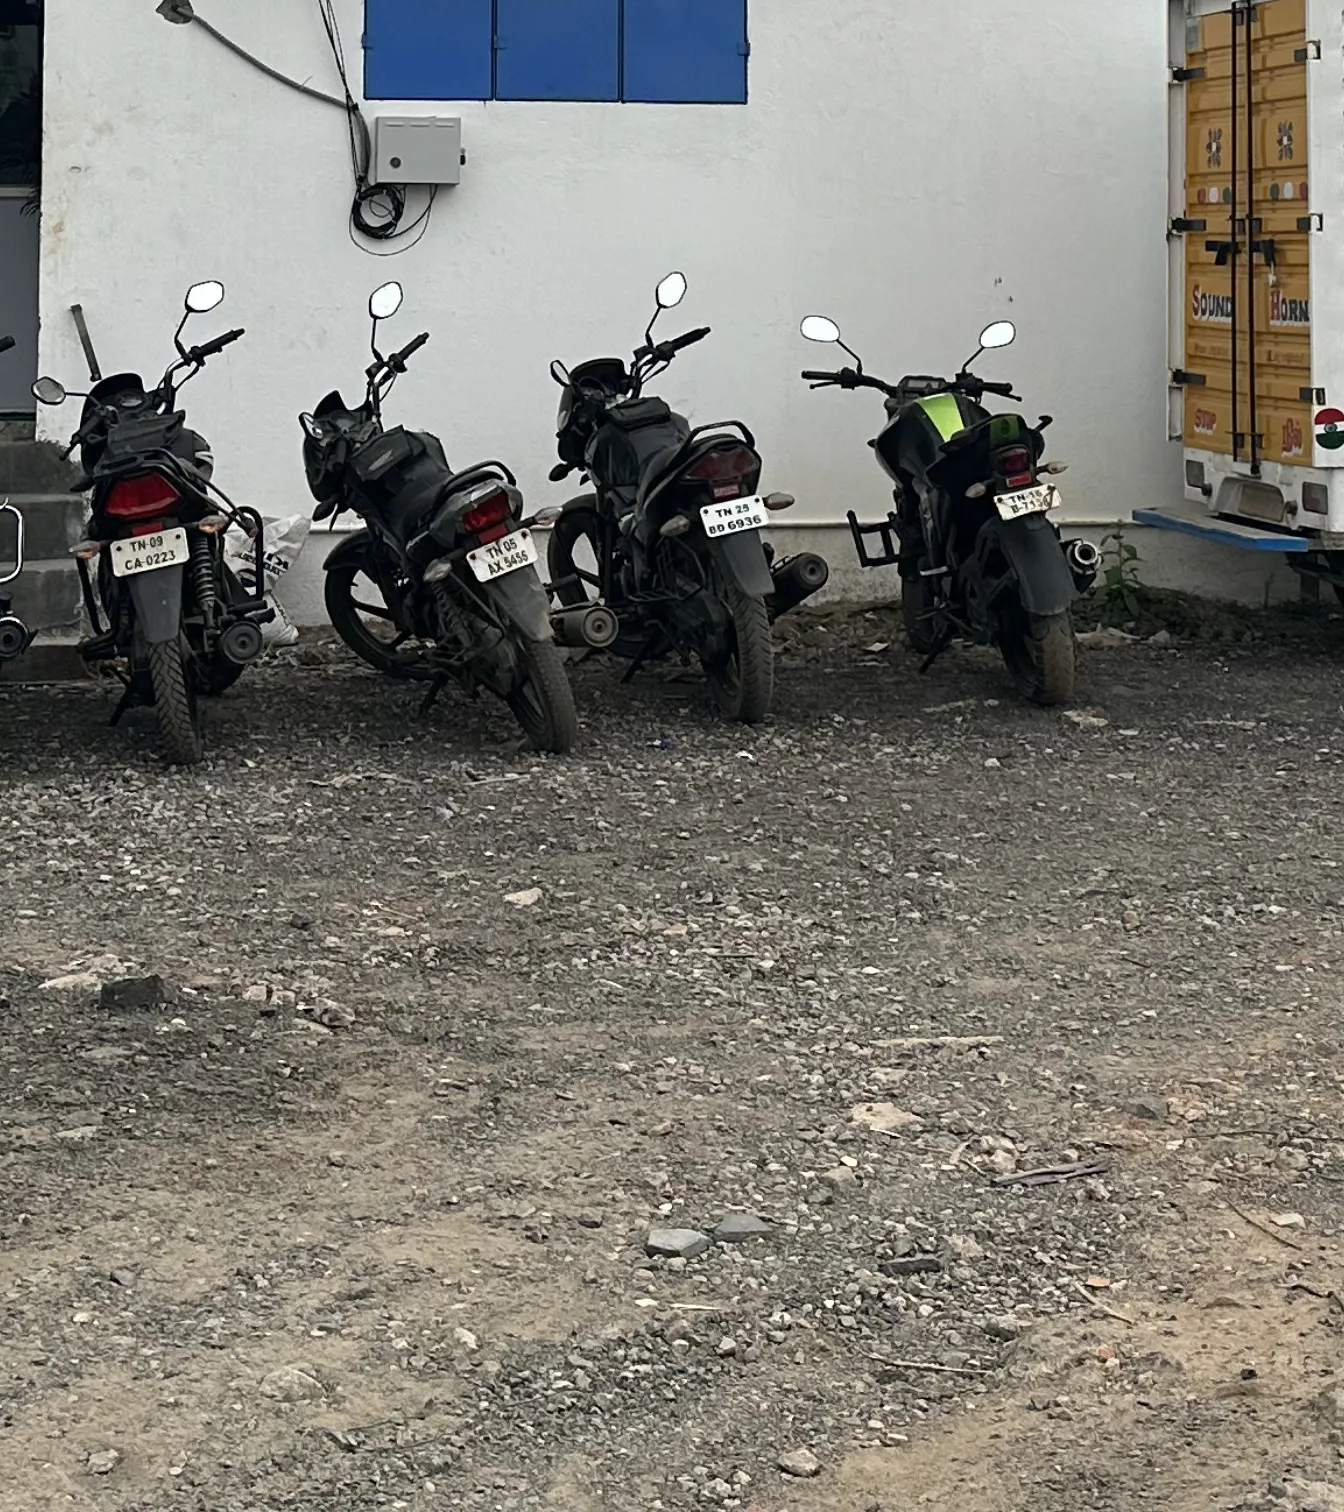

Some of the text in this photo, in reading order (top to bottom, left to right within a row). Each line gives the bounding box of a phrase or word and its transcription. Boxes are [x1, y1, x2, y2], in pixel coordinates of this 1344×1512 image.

[1192, 284, 1310, 323] SOUND HORN
[715, 508, 733, 518] TN
[130, 535, 164, 552] TN-09
[486, 538, 518, 559] TN 05
[125, 550, 176, 570] CA-0223
[487, 559, 505, 575] AX
